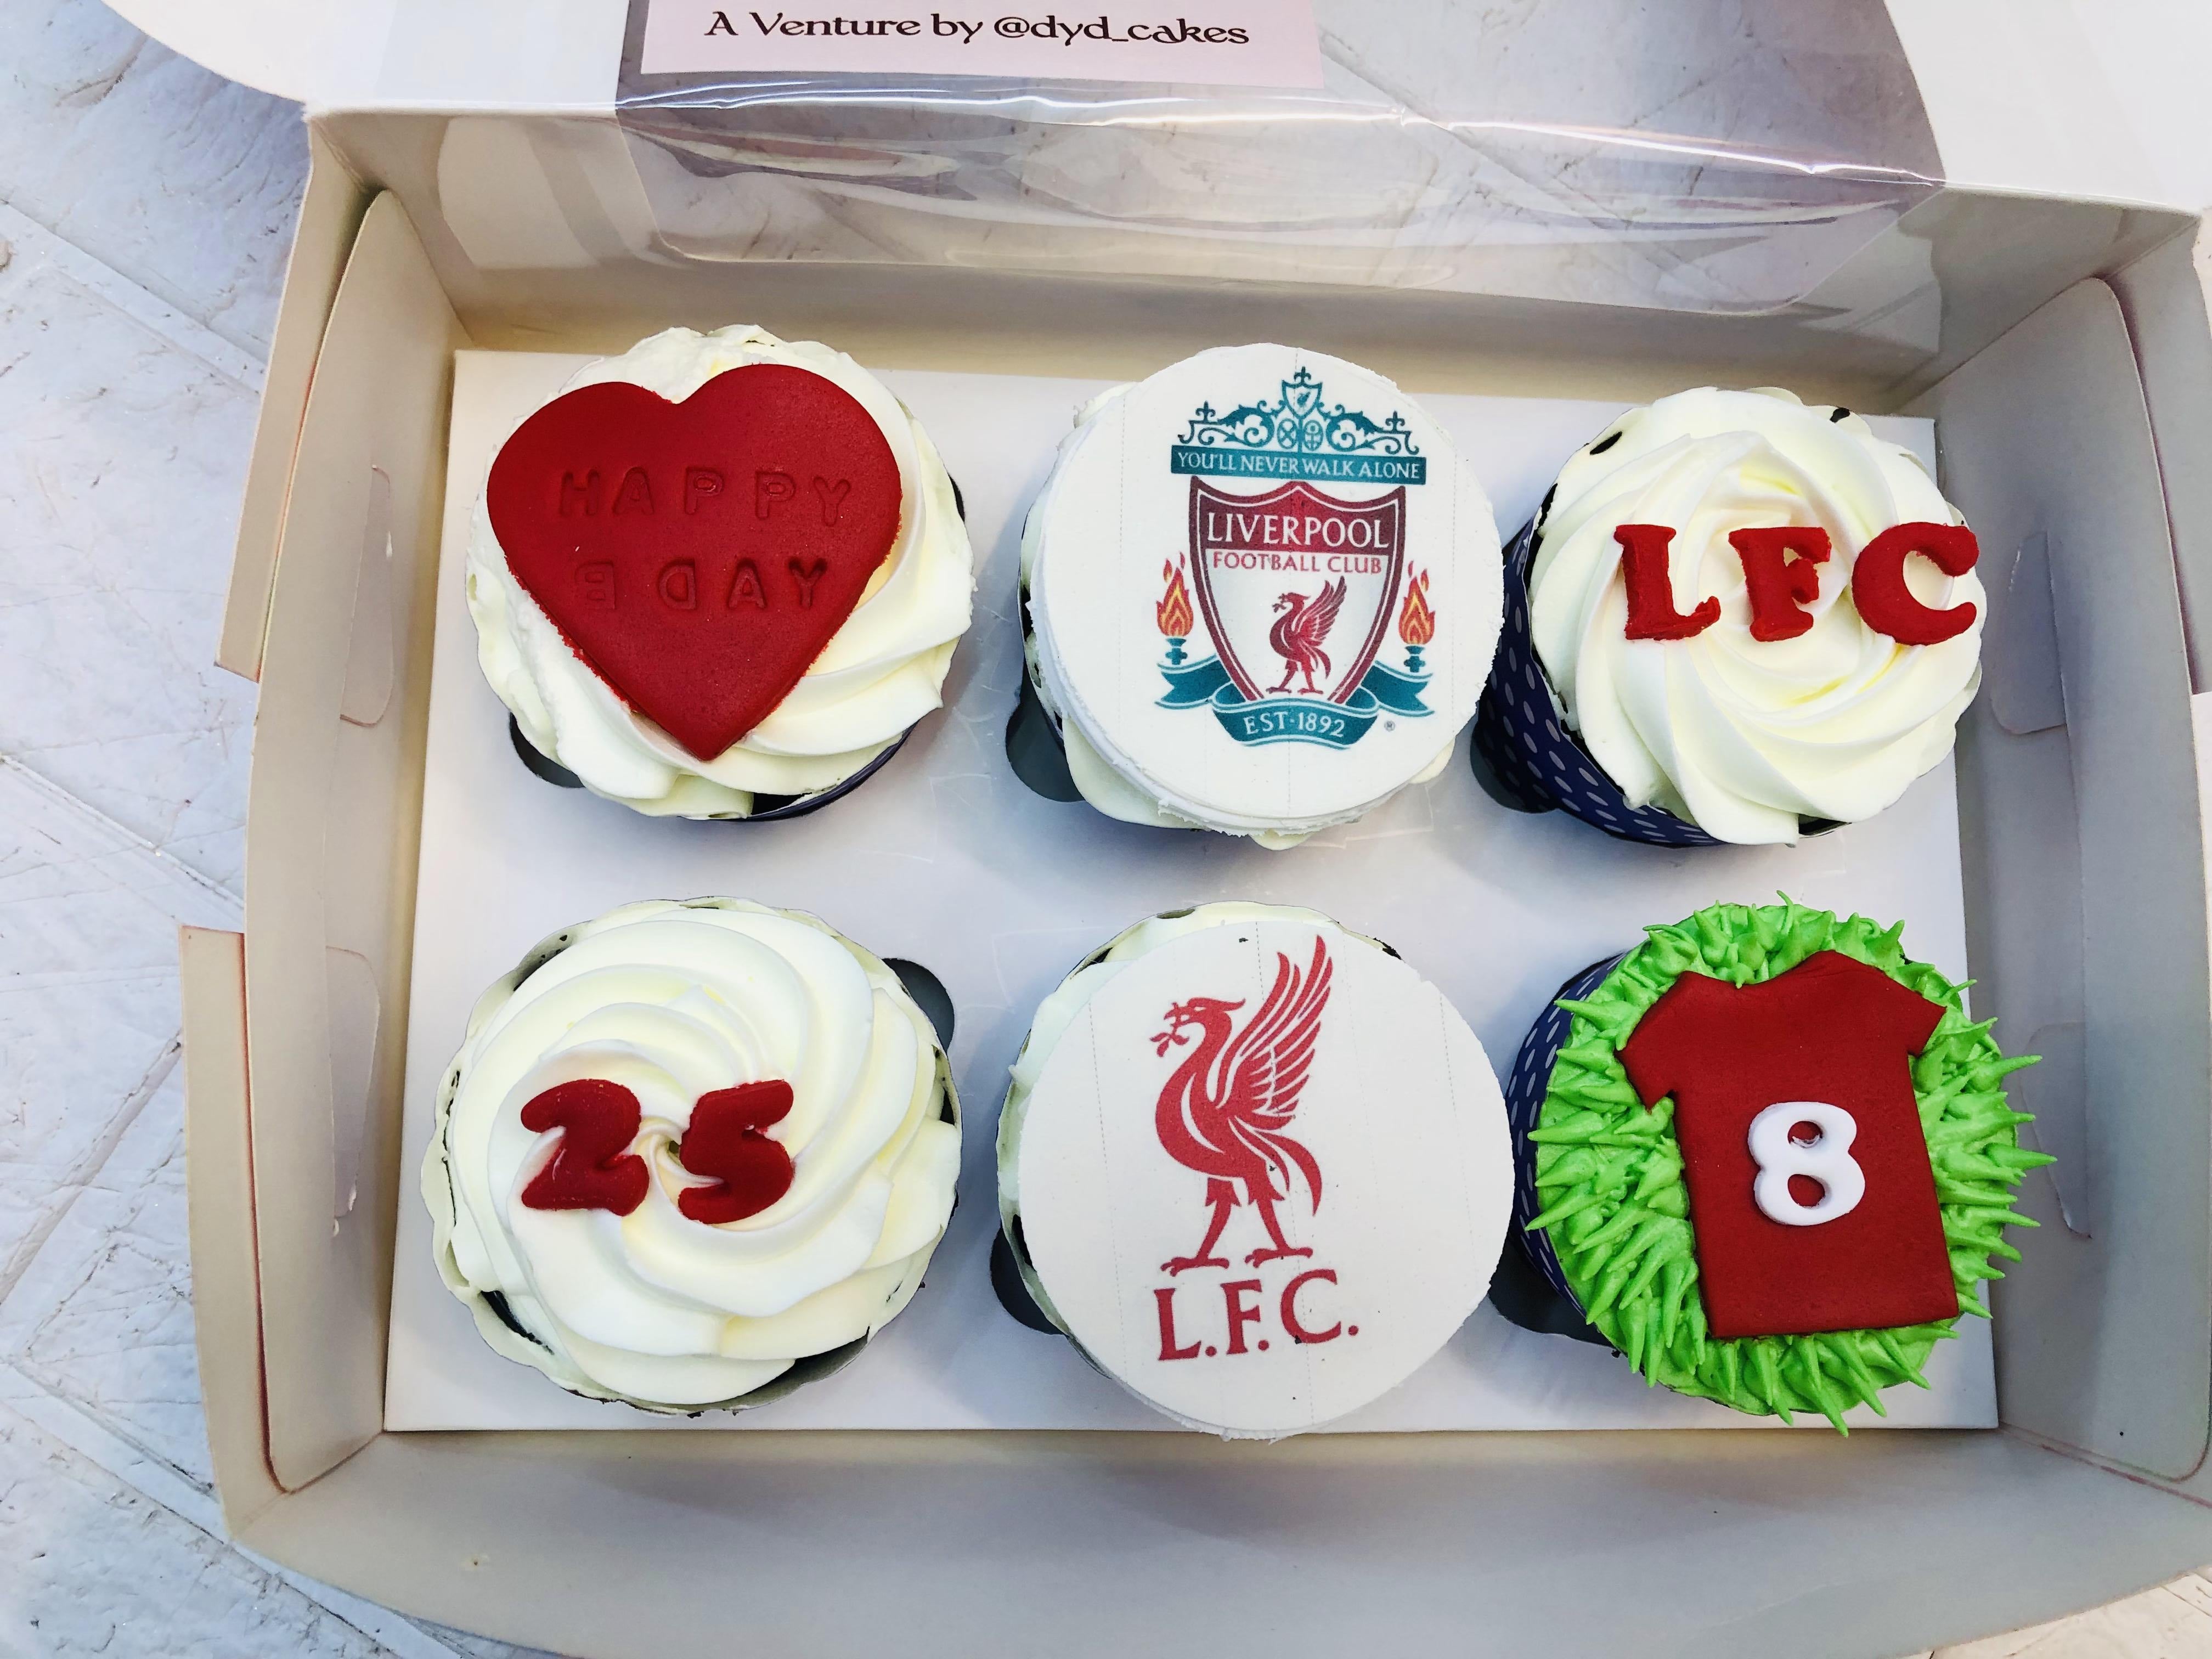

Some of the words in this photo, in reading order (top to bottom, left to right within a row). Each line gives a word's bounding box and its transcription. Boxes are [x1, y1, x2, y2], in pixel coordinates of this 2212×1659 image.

[704, 11, 738, 36] A
[749, 12, 921, 36] Venture
[930, 13, 983, 44] by
[994, 15, 1249, 46] @dyd_cakes
[1177, 452, 1236, 471] YOU'LL
[1240, 457, 1300, 474] NEVER
[1302, 459, 1354, 477] WALK
[1359, 460, 1420, 478] ALONE
[559, 466, 851, 527] HAPPY
[1207, 512, 1389, 548] LIVERPOOL
[1213, 551, 1321, 572] FOOTBALL
[1327, 556, 1382, 574] CLUB
[521, 1078, 794, 1224] 25
[1747, 1102, 1865, 1226] 8
[1154, 1269, 1359, 1361] L.F.C.
